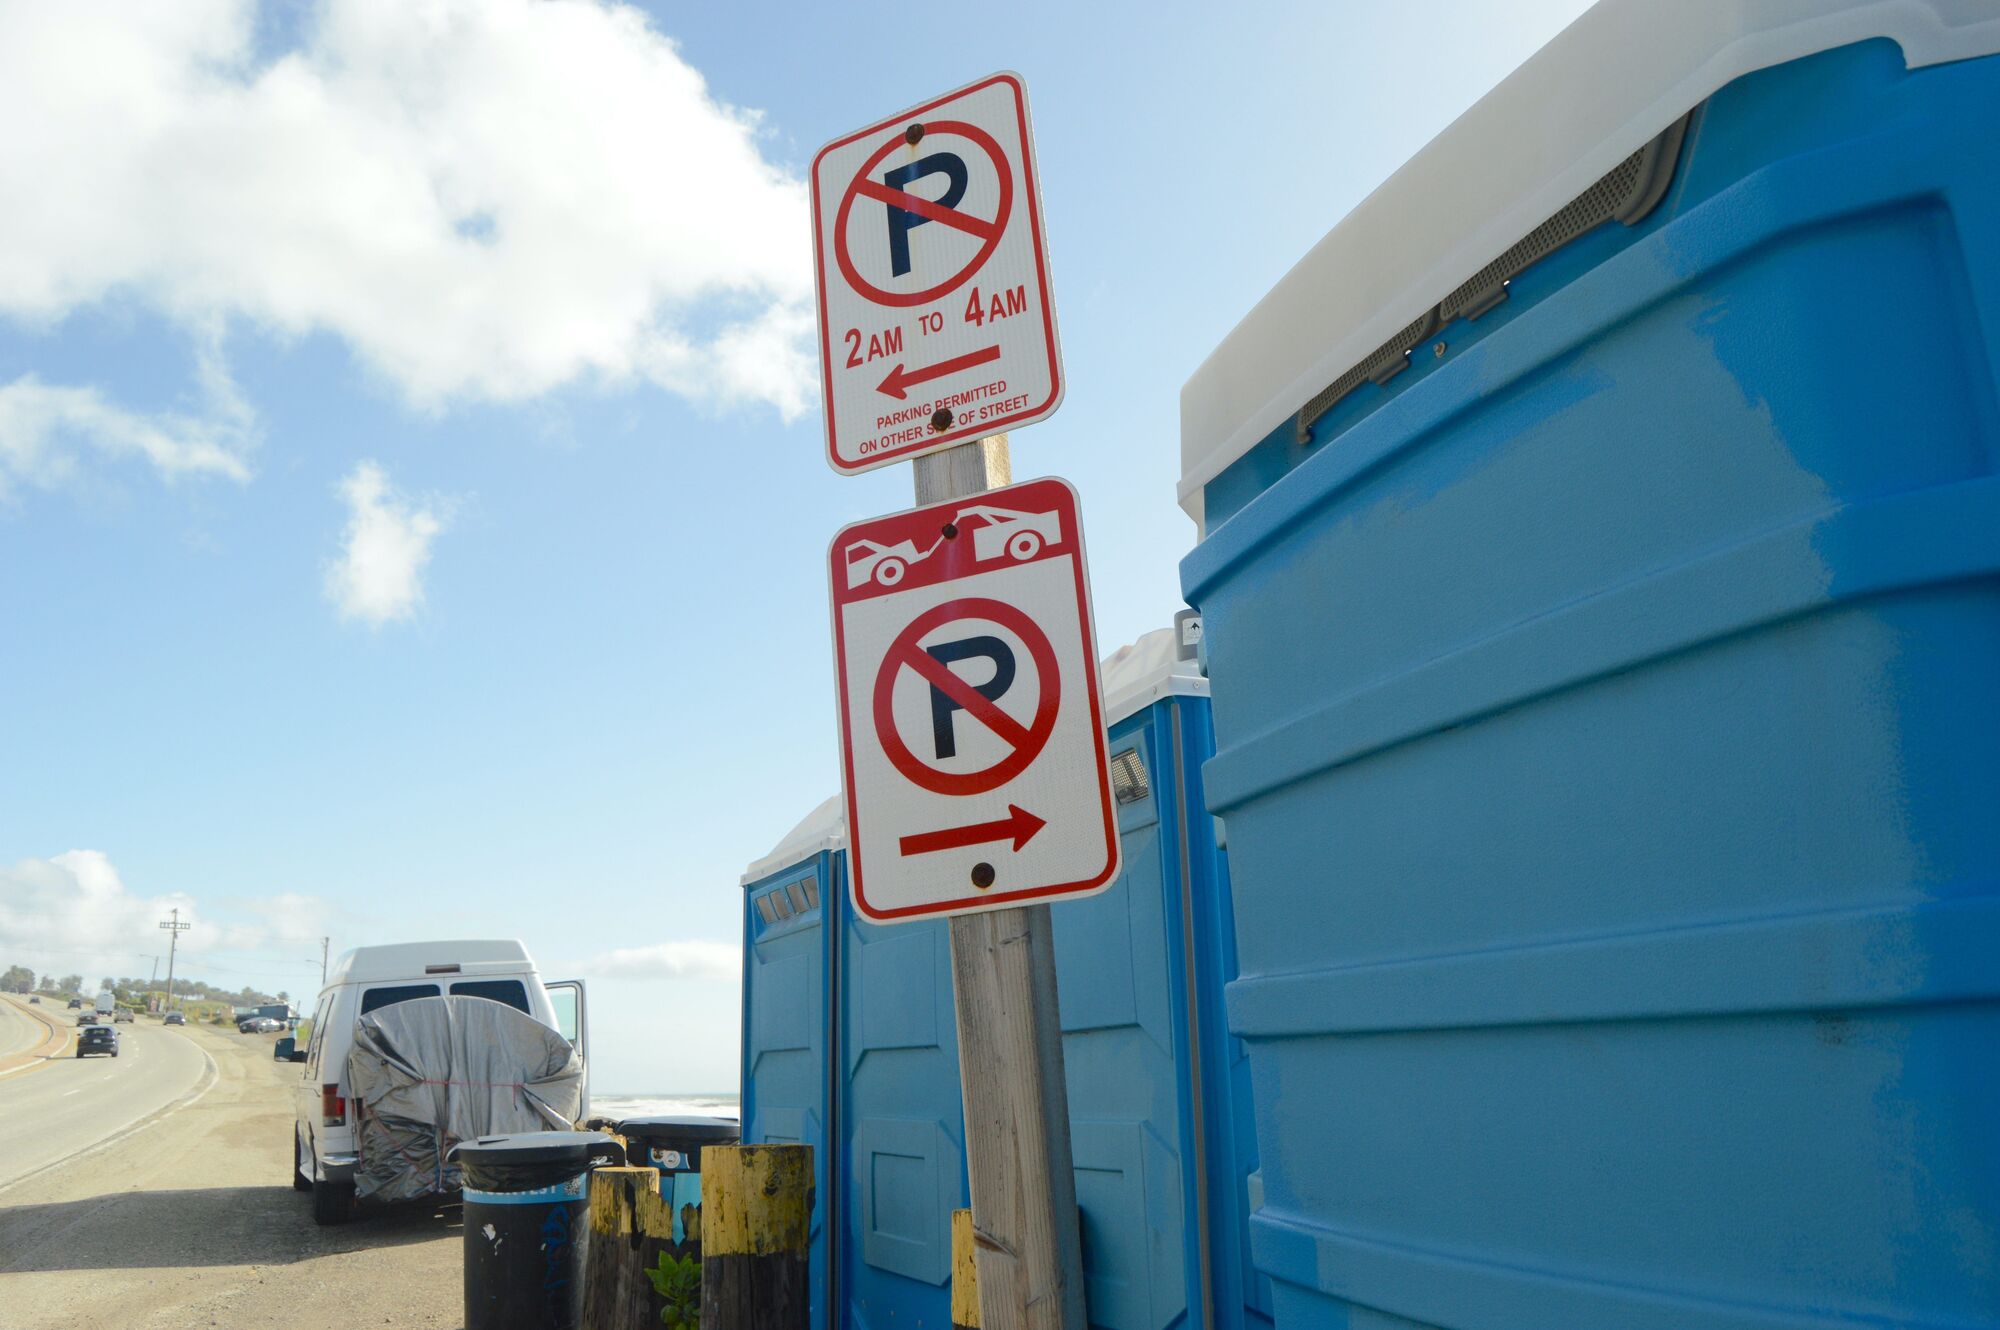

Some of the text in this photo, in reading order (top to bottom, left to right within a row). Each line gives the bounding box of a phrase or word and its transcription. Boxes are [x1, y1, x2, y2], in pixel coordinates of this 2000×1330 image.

[884, 152, 968, 277] P
[918, 312, 943, 335] TO
[859, 439, 877, 454] ON
[880, 426, 923, 447] OTHER
[958, 411, 975, 425] OF
[979, 394, 1029, 420] STREET
[877, 380, 1007, 429] PARKING PERMITTED
[926, 635, 1016, 759] P
